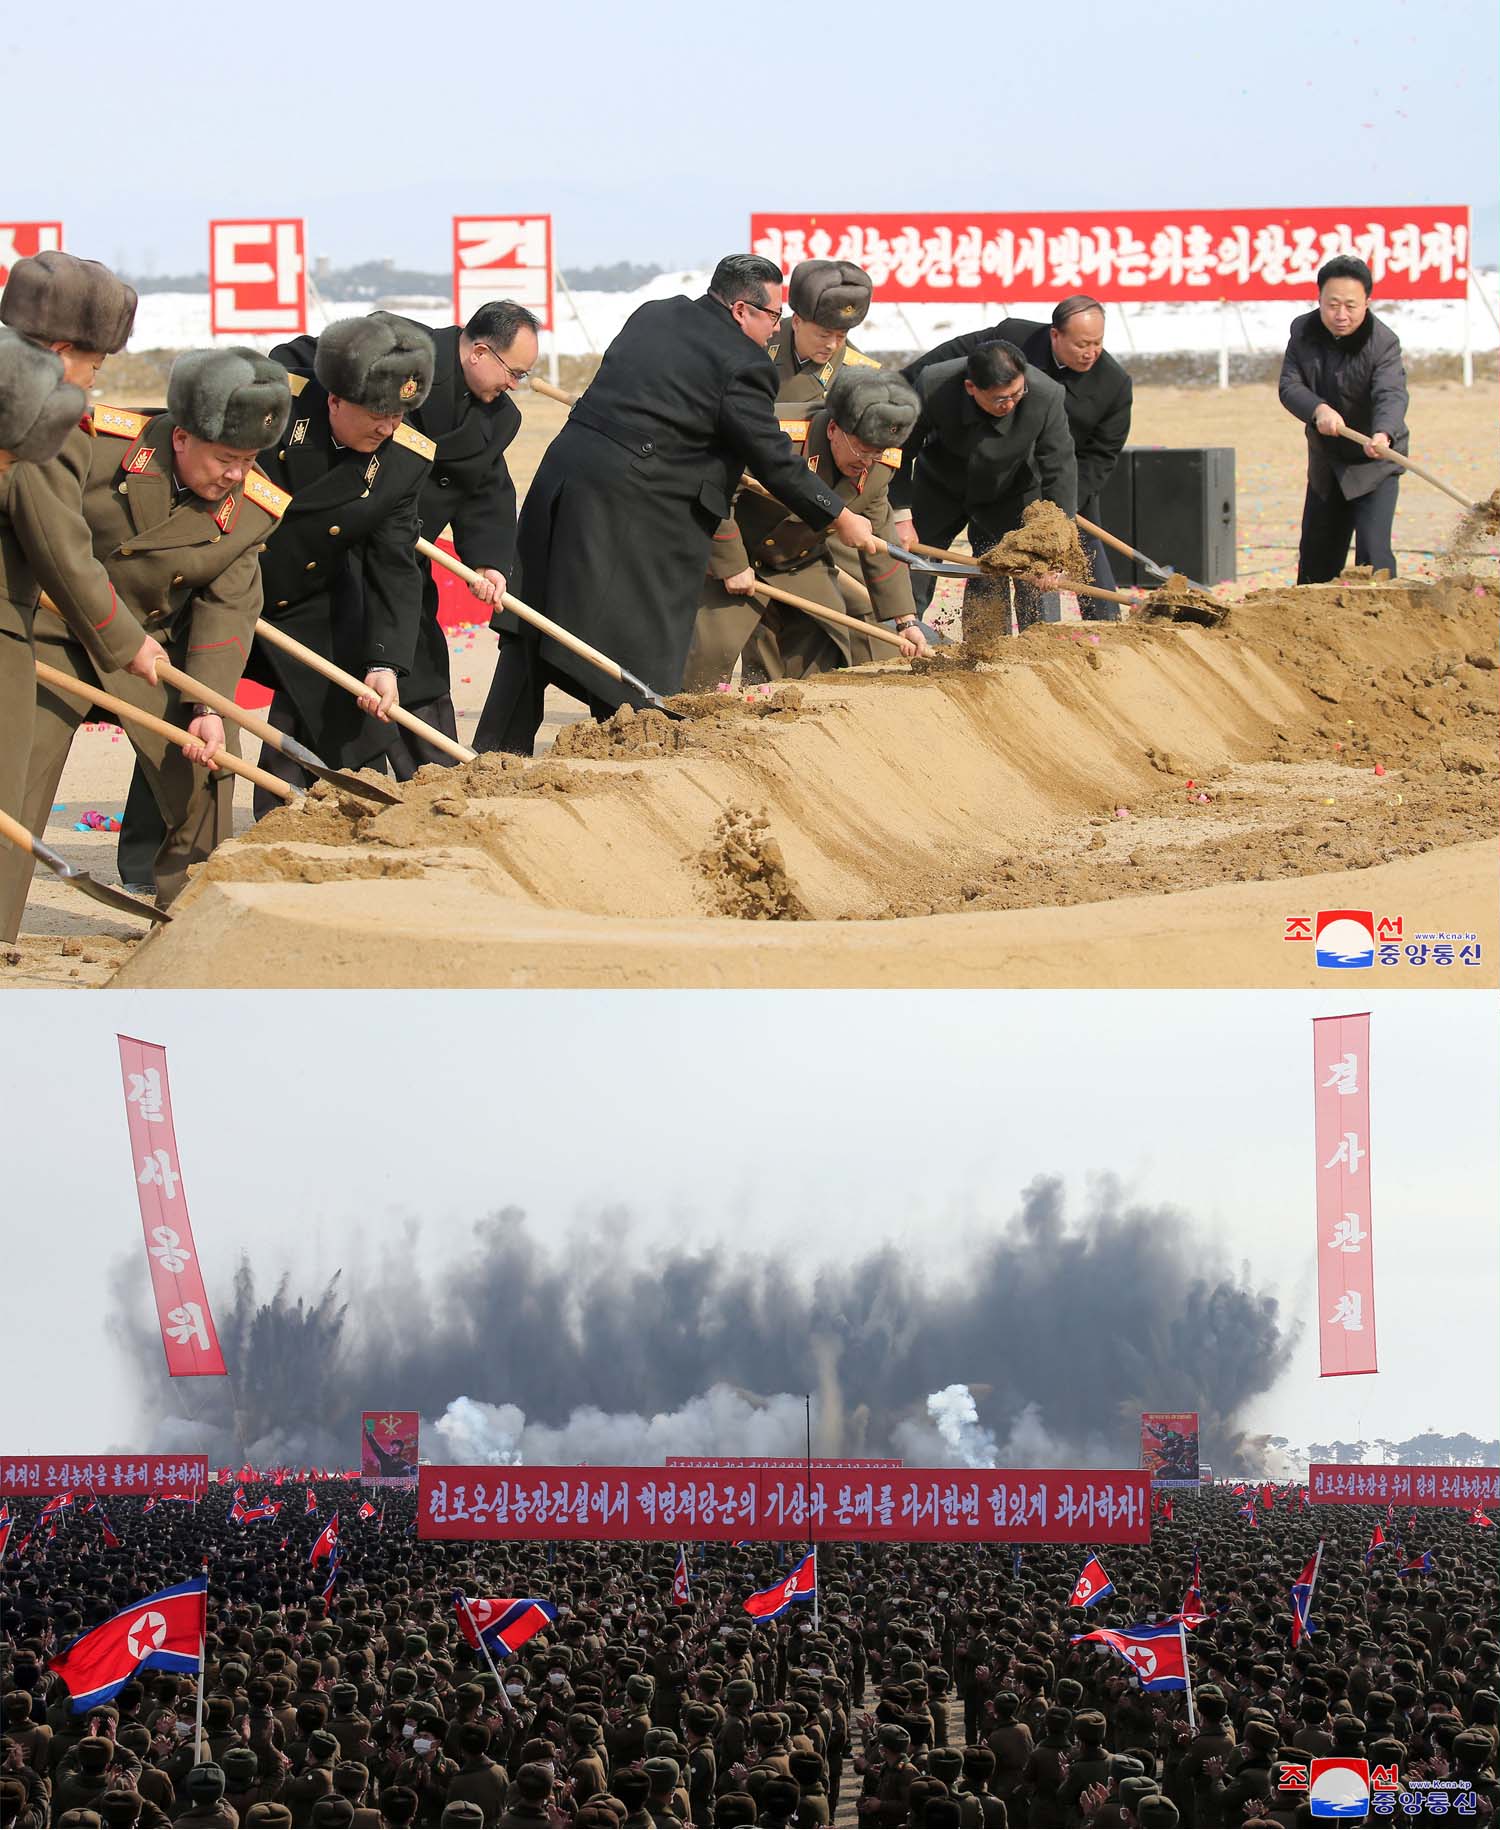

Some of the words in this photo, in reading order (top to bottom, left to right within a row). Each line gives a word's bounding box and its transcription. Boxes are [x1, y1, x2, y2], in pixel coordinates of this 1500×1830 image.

[214, 225, 303, 328] 단
[763, 1482, 828, 1526] 기상과
[986, 1484, 1047, 1527] 힘있게
[1054, 1485, 1144, 1528] 과시하자!
